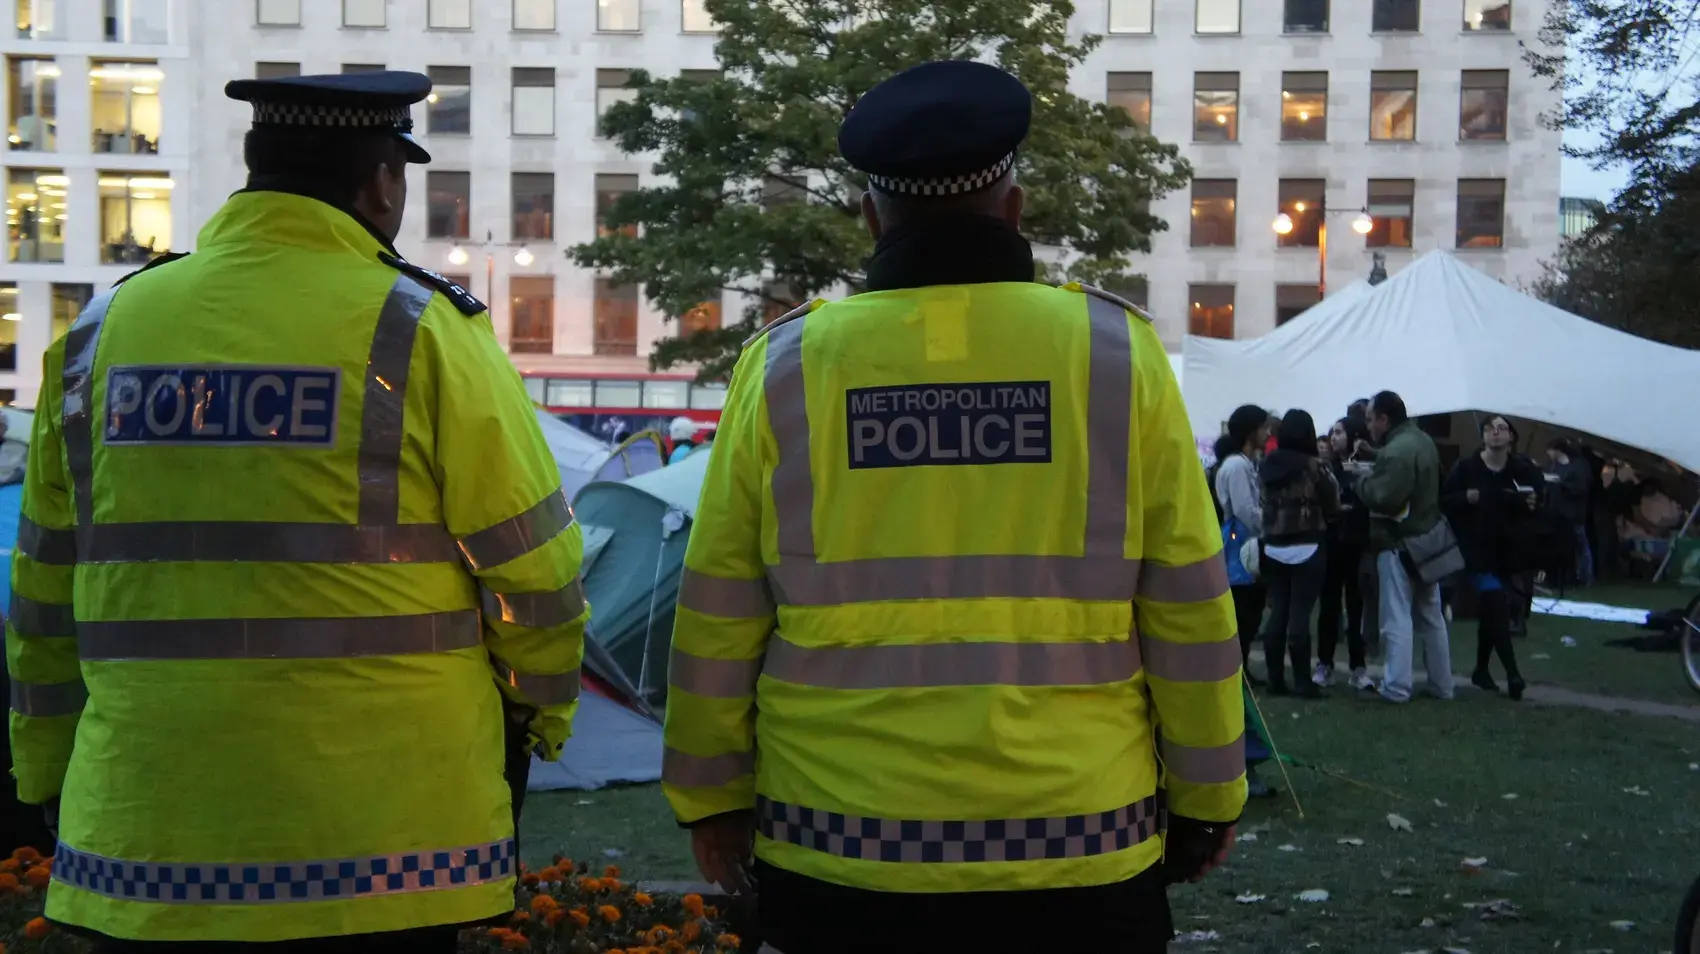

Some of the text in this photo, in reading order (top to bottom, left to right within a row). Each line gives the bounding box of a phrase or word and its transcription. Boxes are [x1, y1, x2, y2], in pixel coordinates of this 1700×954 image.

[108, 374, 330, 437] POLICE
[851, 387, 1046, 414] METROPOLITAN
[853, 414, 1046, 462] POLICE
